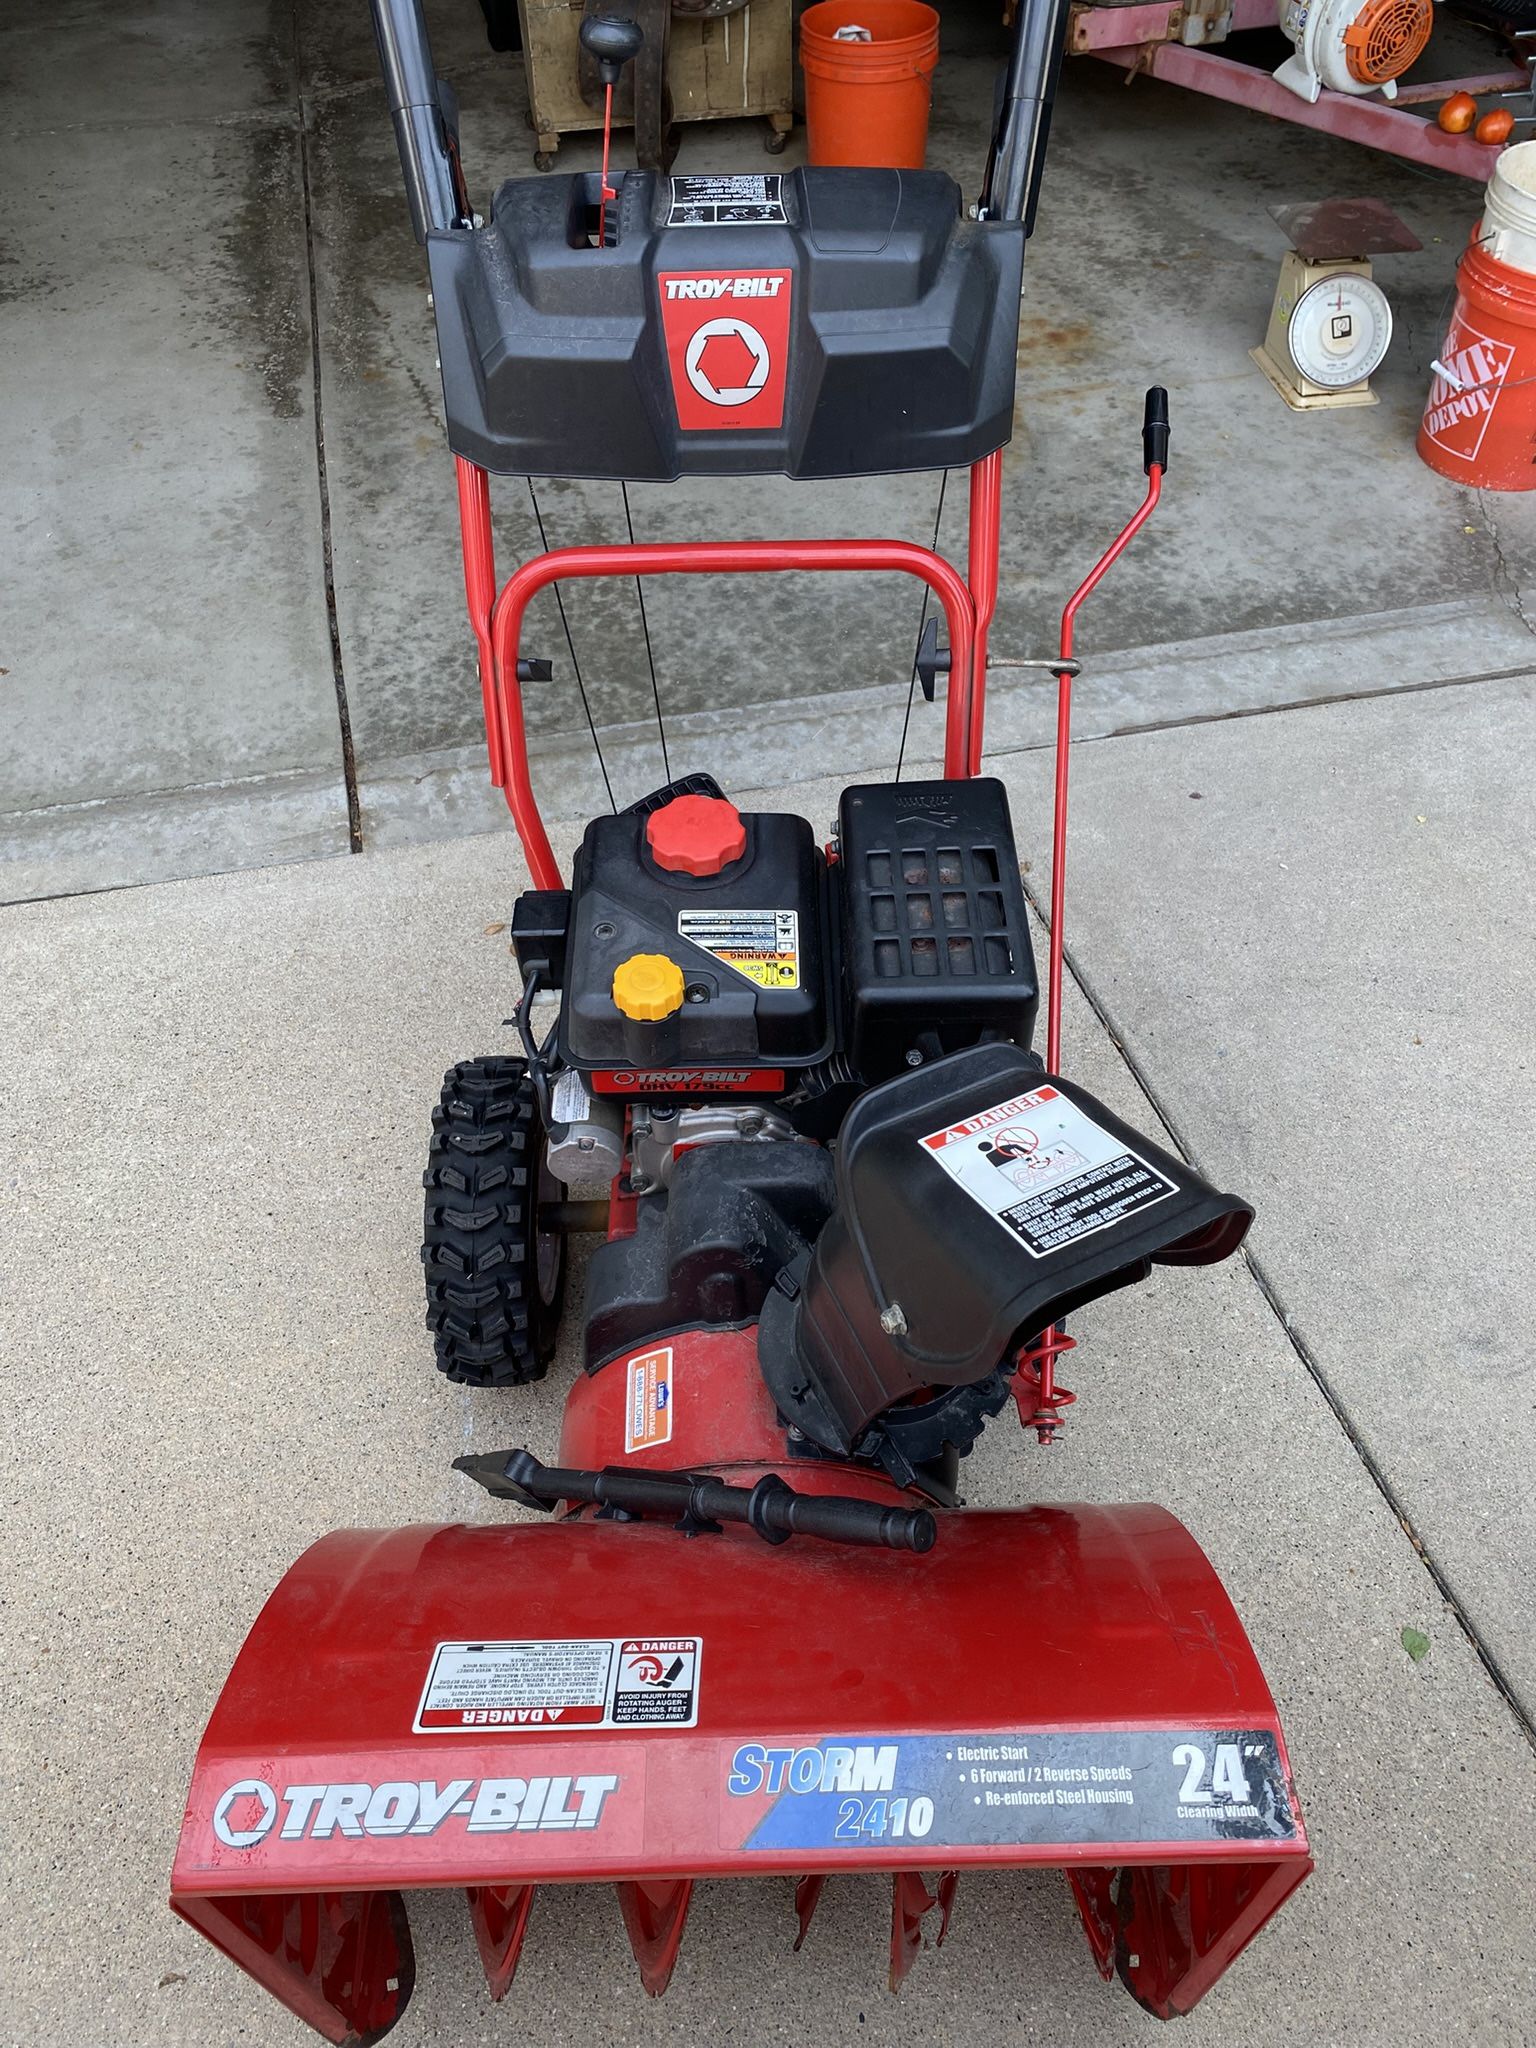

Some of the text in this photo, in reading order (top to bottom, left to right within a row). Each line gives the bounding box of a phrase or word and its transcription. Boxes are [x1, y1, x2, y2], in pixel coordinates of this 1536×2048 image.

[666, 278, 784, 299] TROY-BILT
[1429, 388, 1491, 435] DEPOT
[638, 1072, 752, 1083] TROY-BILT
[966, 1093, 1044, 1131] DANGER
[1007, 1202, 1030, 1215] NEVER
[1027, 1197, 1042, 1206] PUT
[1039, 1189, 1059, 1200] HAND
[1085, 1164, 1115, 1179] CONTACT
[1112, 1156, 1131, 1167] WITH
[1011, 1160, 1136, 1219] ROTATING PARTS CAN AMPUTATE FINGERS
[1021, 1169, 1147, 1229] SHUT OFF ENGINE AND WAIT UNTIL ALL
[1026, 1173, 1152, 1234] MOVING PARTS HAVE STOPPED BEFORE
[1016, 1203, 1056, 1224] AND HANDS.
[1037, 1234, 1053, 1244] USE
[1049, 1219, 1086, 1238] CLEAN-OUT
[1082, 1212, 1102, 1223] TOOL
[1108, 1195, 1137, 1211] WOODEN
[1133, 1187, 1155, 1199] STICK
[1042, 1206, 1128, 1249] UNCLOG DISCHARGE CHUTE.
[641, 1642, 694, 1651] DANGER
[461, 1709, 545, 1723] DANGER
[728, 1744, 898, 1795] STORM
[958, 1746, 1028, 1760] Electric Start
[1172, 1744, 1264, 1802] 24"
[970, 1769, 978, 1783] 6
[980, 1768, 1026, 1782] Forward
[1034, 1767, 1042, 1782] 2
[1043, 1767, 1088, 1782] Reverse
[1090, 1766, 1132, 1782] Speeds
[280, 1774, 621, 1840] TROY-BILT
[835, 1797, 934, 1838] 2410
[986, 1788, 1134, 1806] Re-enforced Steel Housing
[1176, 1805, 1258, 1818] Clearing Width
